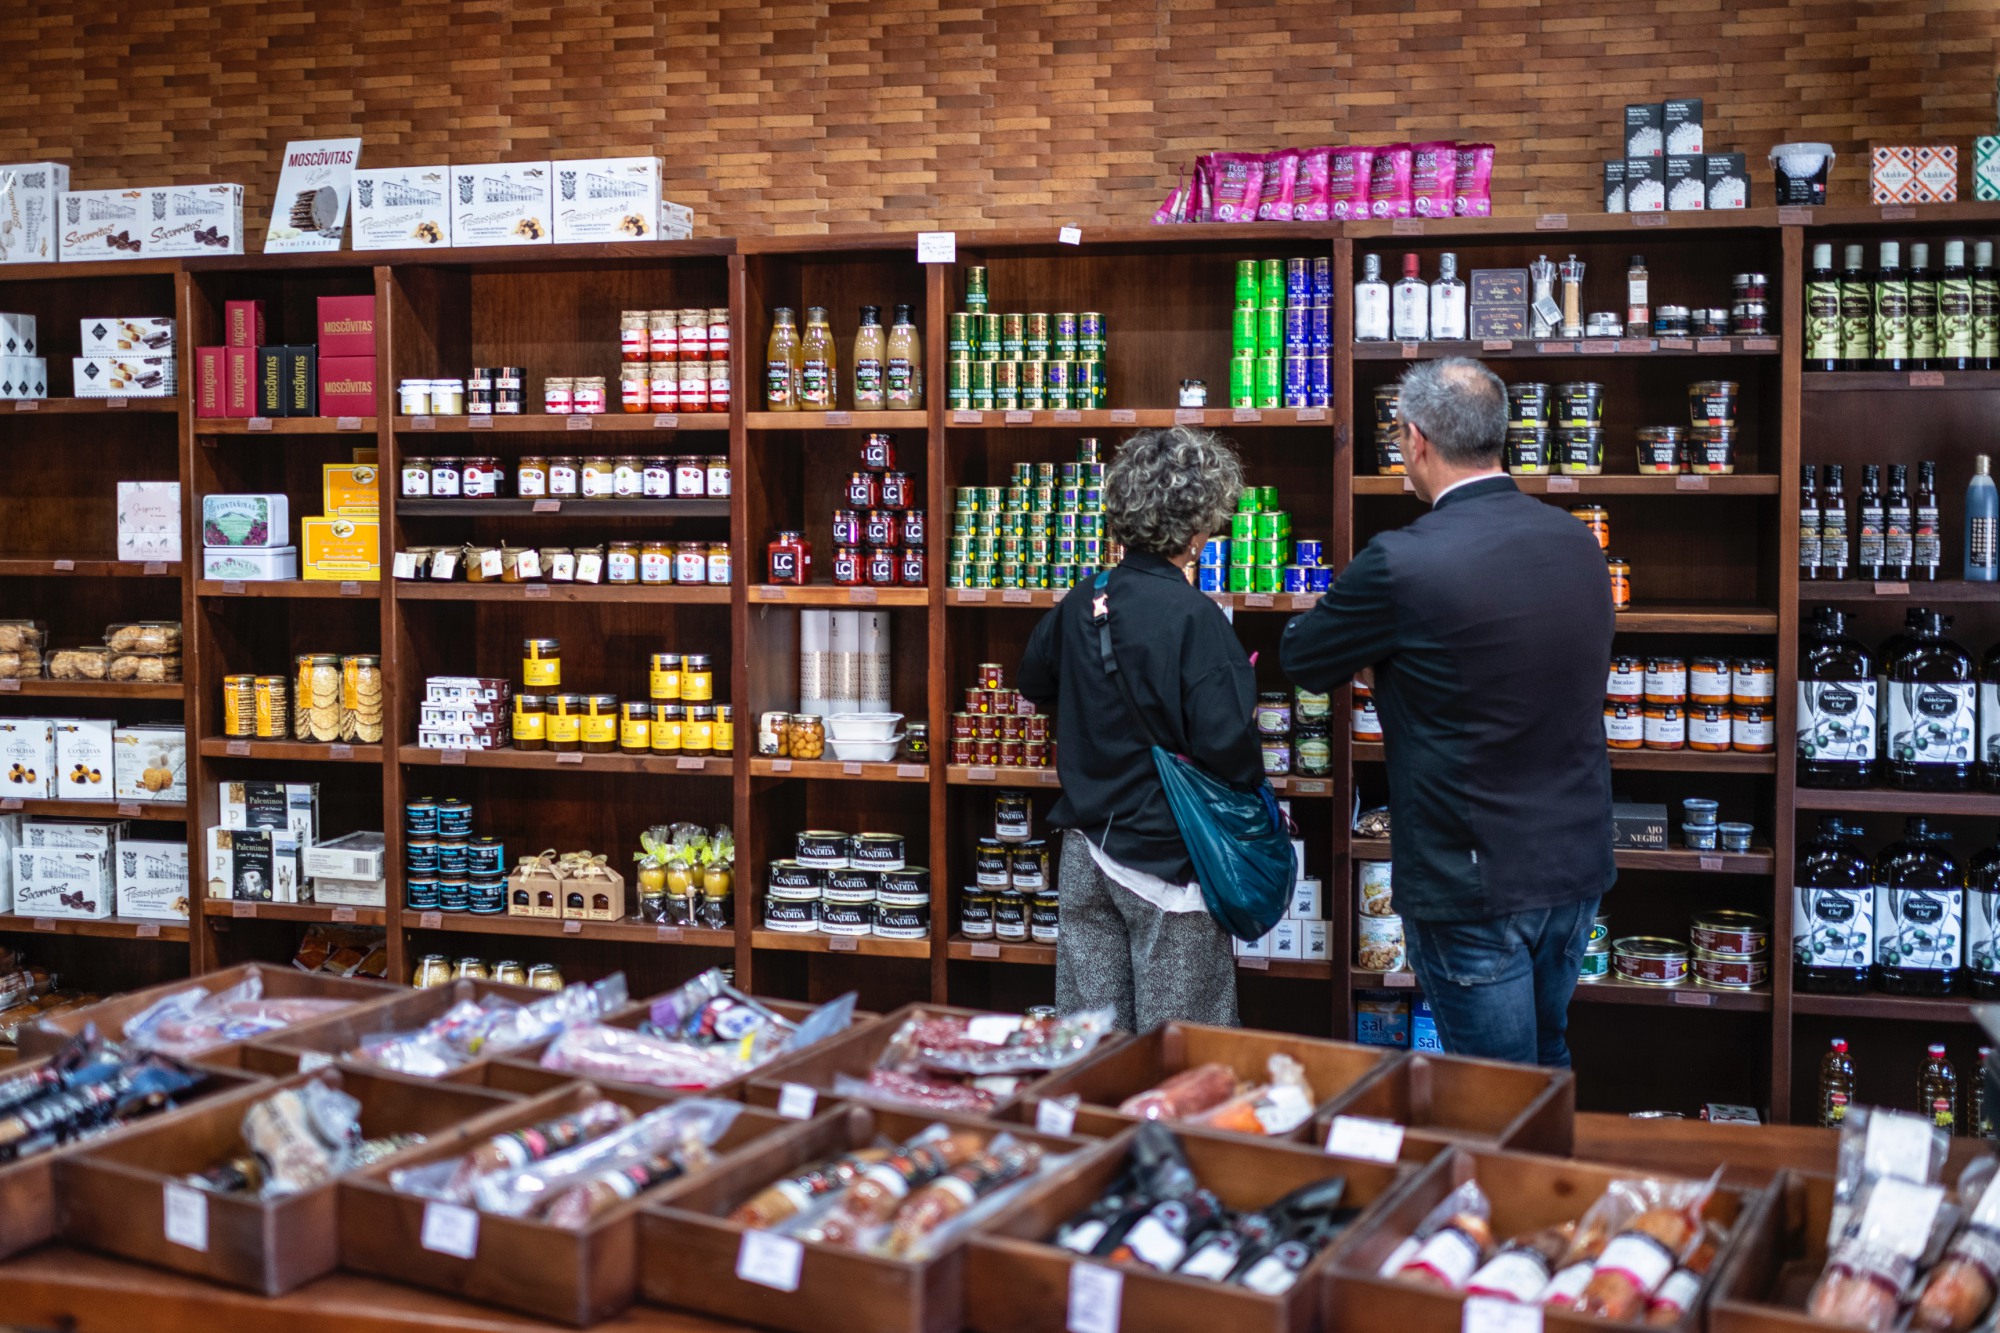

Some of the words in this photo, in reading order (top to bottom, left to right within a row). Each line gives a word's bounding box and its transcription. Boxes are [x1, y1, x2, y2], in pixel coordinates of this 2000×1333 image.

[1336, 156, 1353, 164] FLOR
[1377, 156, 1392, 166] FLOR
[1418, 152, 1437, 160] FLOR
[1881, 170, 1908, 179] Maldon
[1923, 170, 1950, 178] Maldon
[63, 223, 116, 248] Socorritos
[149, 219, 203, 244] Socorritos
[234, 308, 245, 346] MOSCOVI
[868, 448, 882, 460] LC
[851, 487, 866, 499] LC
[883, 487, 897, 499] LC
[216, 500, 256, 510] FONTAÑINAS
[834, 525, 847, 537] LC
[869, 525, 883, 537] LC
[906, 525, 921, 537] LC
[774, 556, 792, 570] LC
[836, 563, 850, 575] LC
[873, 564, 889, 575] LC
[904, 564, 919, 575] LC
[1832, 702, 1846, 710] Chef
[1931, 704, 1946, 712] Chef
[229, 810, 238, 824] P
[1646, 826, 1662, 835] AJO
[1630, 834, 1662, 843] NEGRO
[236, 843, 270, 851] Palentinos
[216, 856, 225, 870] P
[17, 882, 68, 902] Socorritos
[1828, 909, 1842, 918] Chef
[1916, 910, 1932, 918] Chef
[1362, 1018, 1383, 1031] sal
